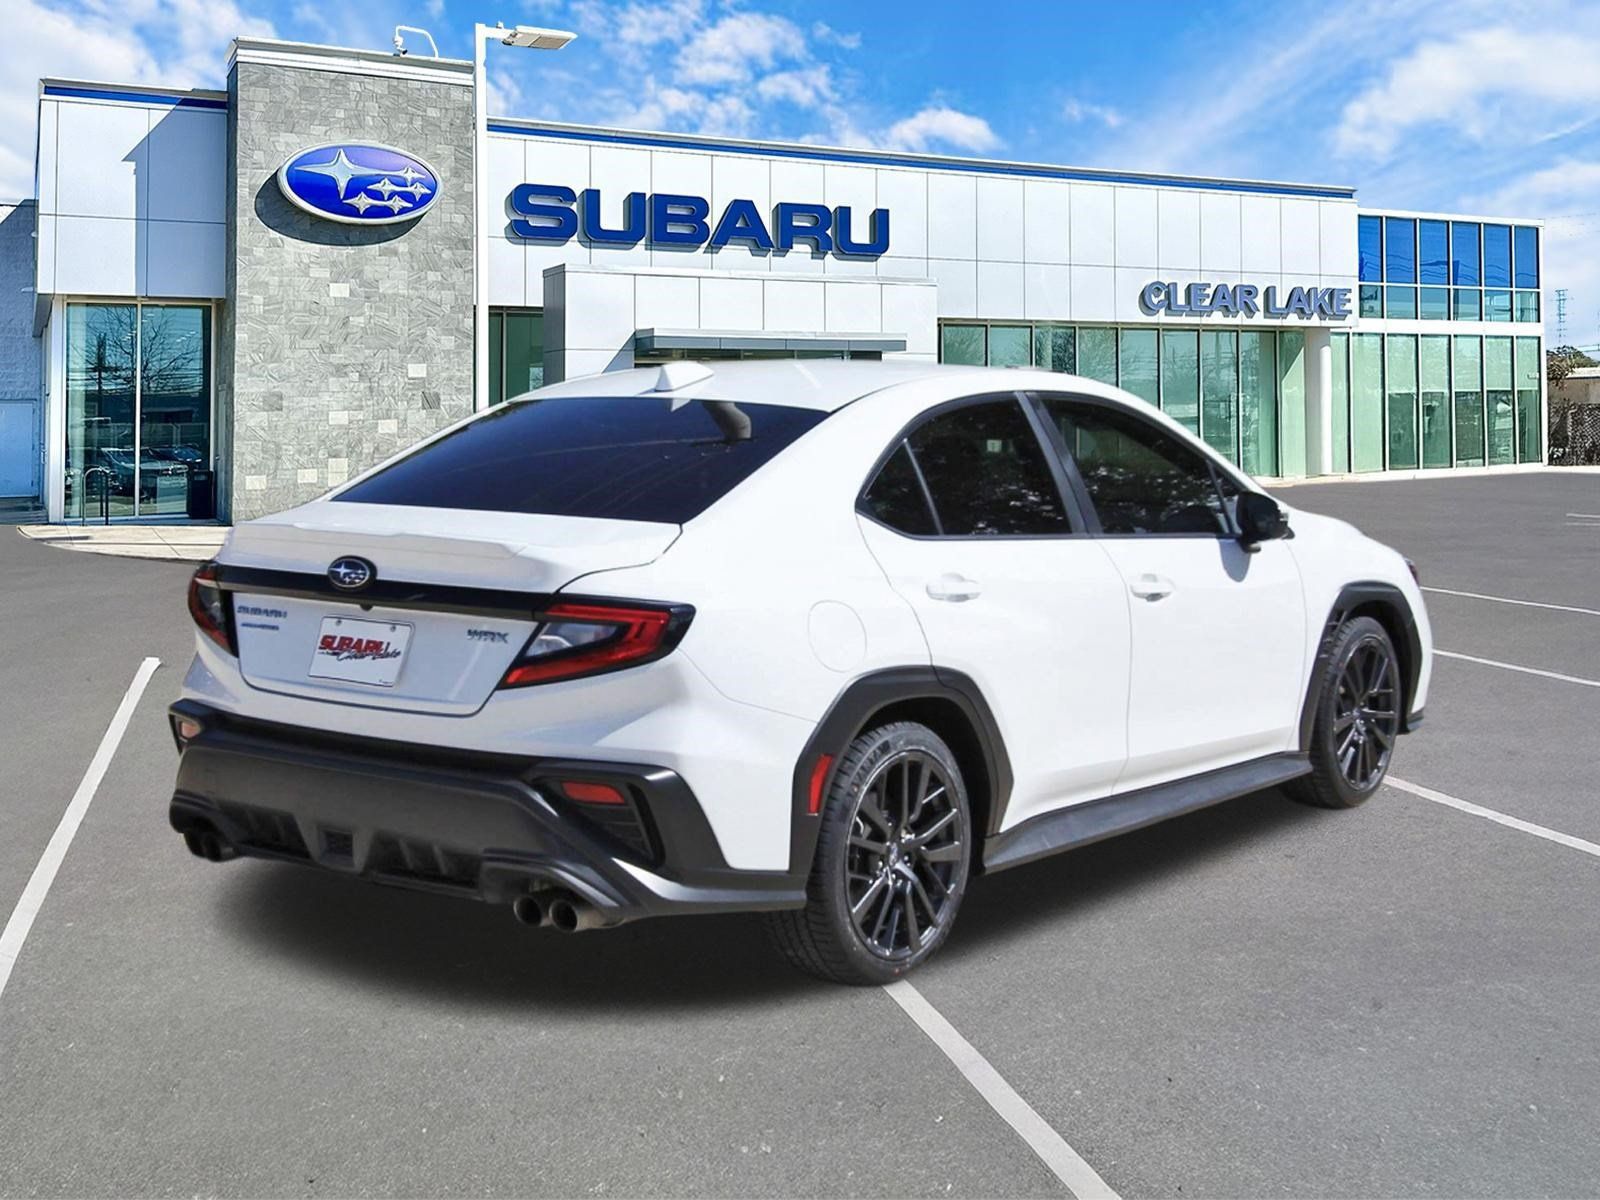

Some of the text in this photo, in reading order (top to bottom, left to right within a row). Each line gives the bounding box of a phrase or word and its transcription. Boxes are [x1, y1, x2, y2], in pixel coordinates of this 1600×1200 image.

[505, 183, 890, 260] SUBARU
[1140, 281, 1352, 320] CLEAR LAKE
[237, 605, 288, 618] SUBARU
[467, 629, 509, 644] WRX
